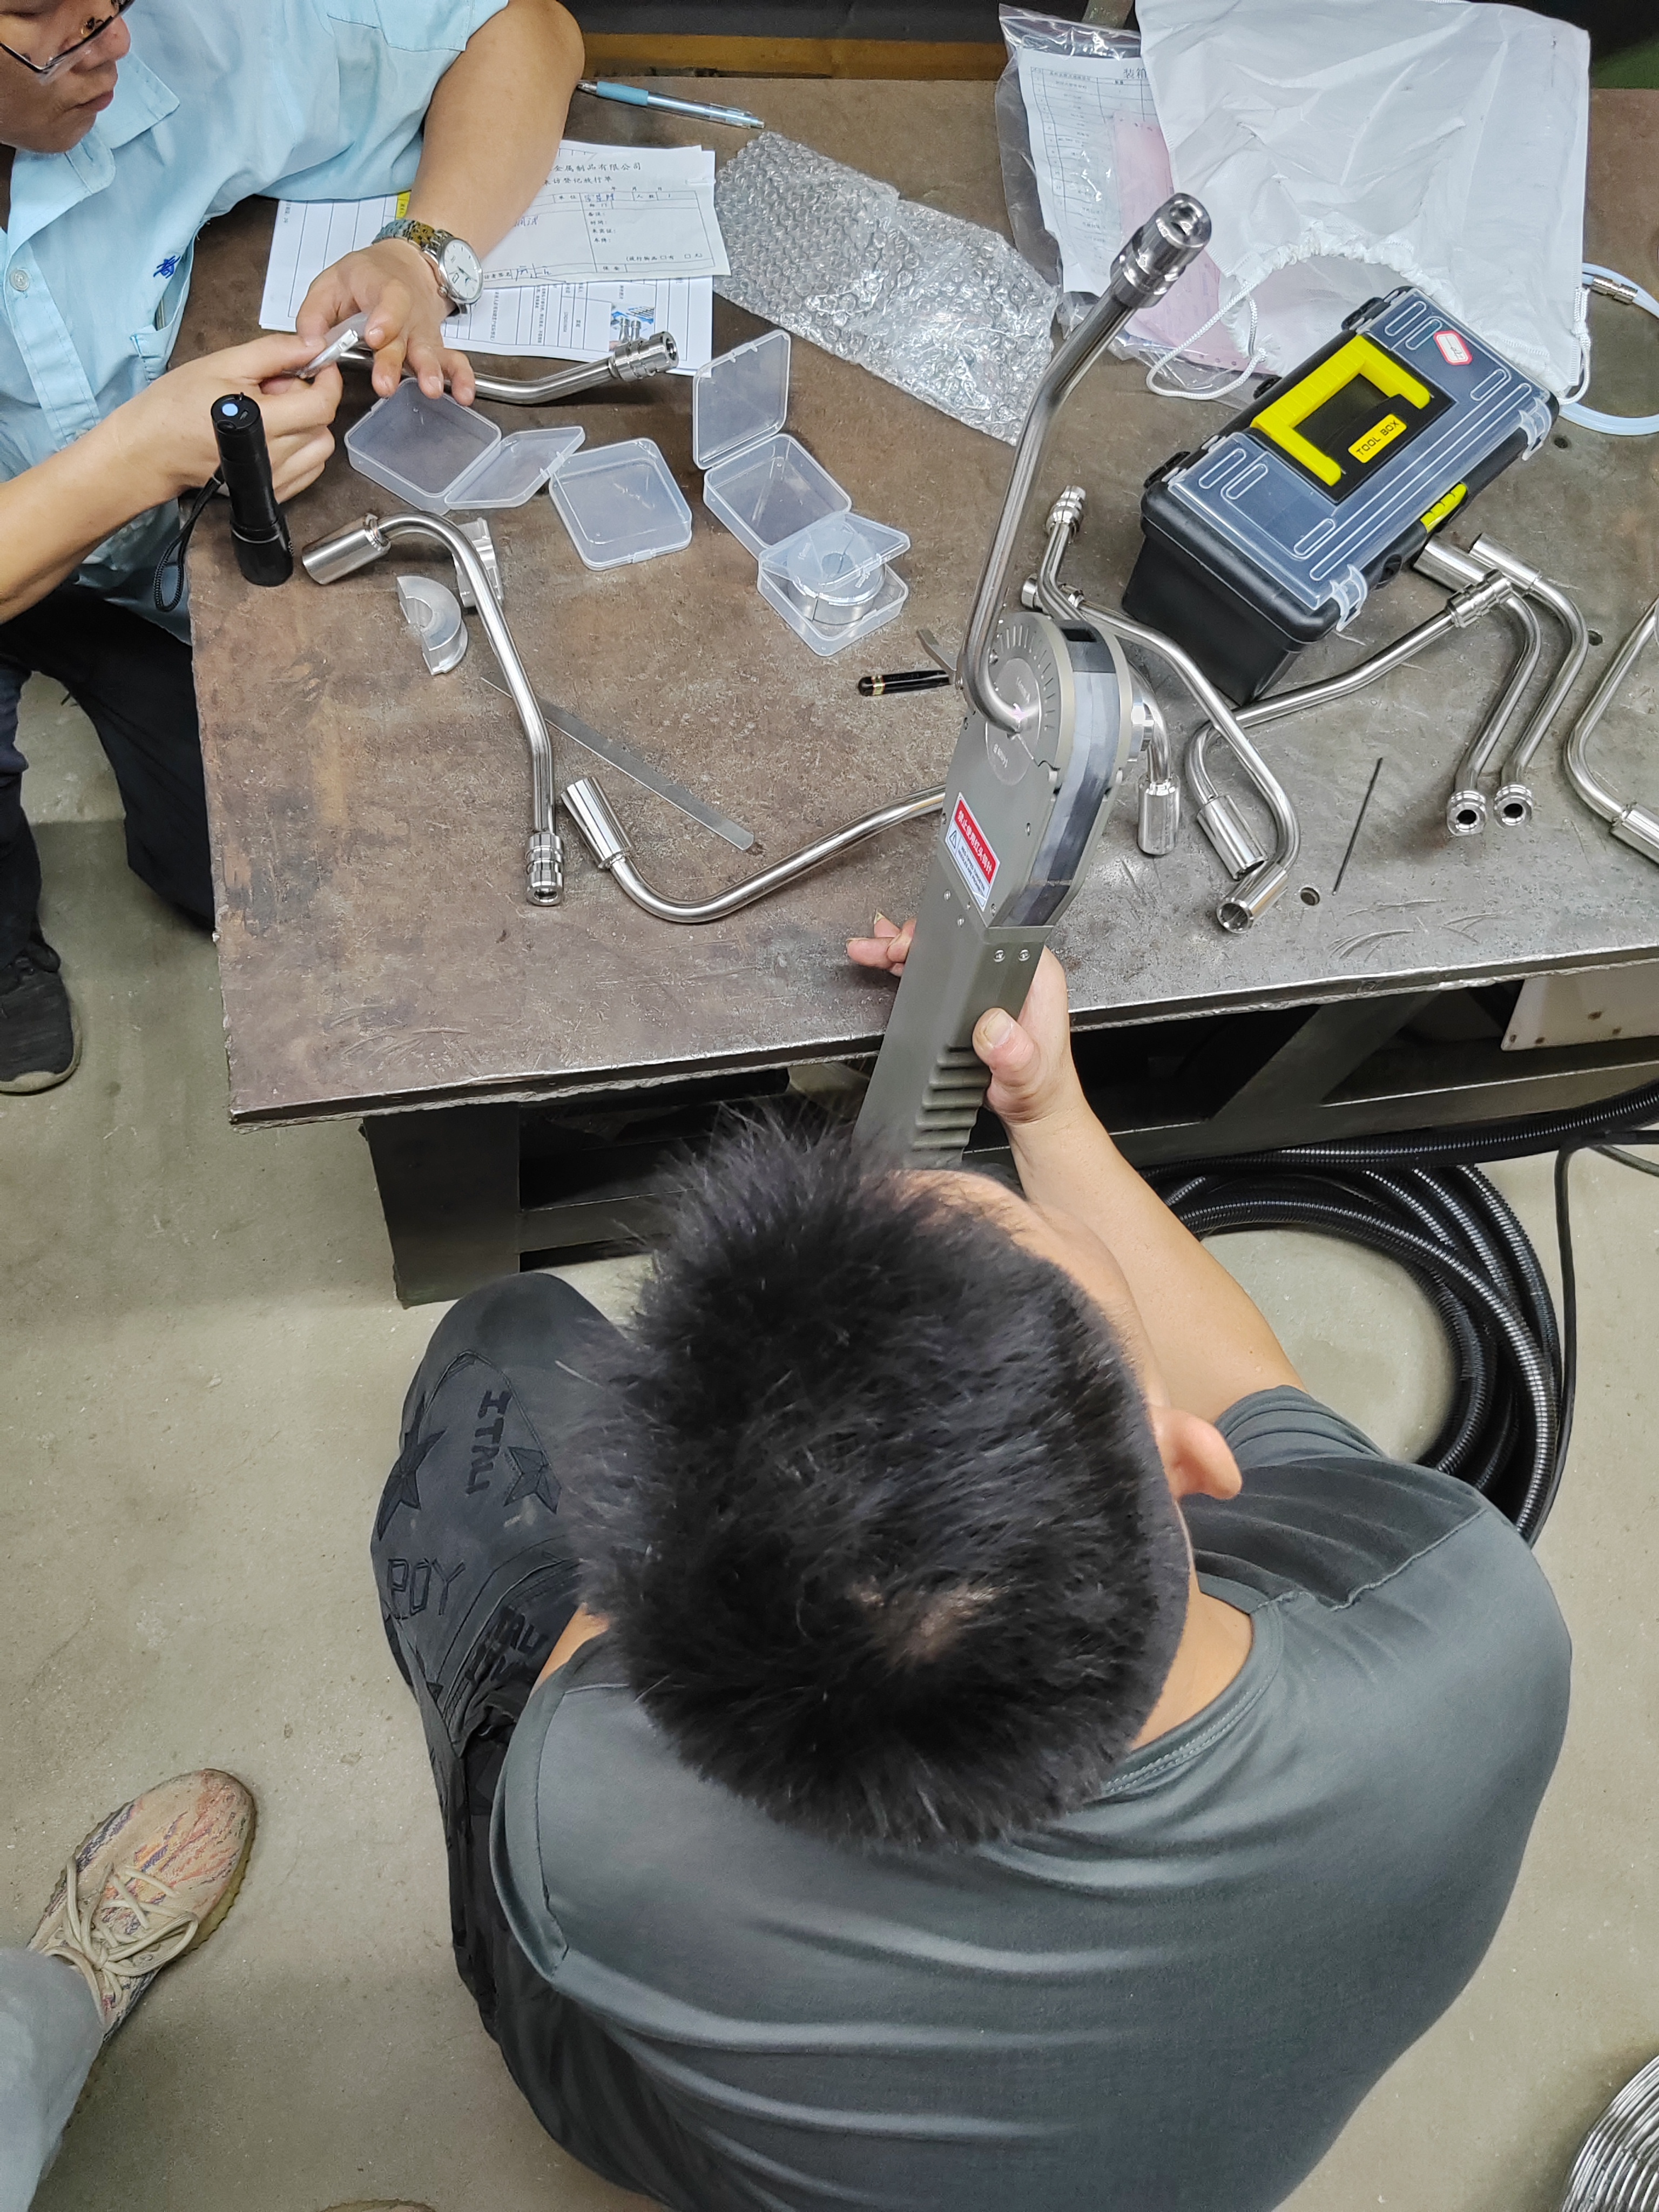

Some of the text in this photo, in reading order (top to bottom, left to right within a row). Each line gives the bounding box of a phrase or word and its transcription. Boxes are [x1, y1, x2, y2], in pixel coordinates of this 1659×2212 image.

[554, 163, 642, 172] 金属制品有限公司
[1356, 420, 1400, 455] TOOL BOX
[957, 810, 992, 875] 禁止使用红头钨针
